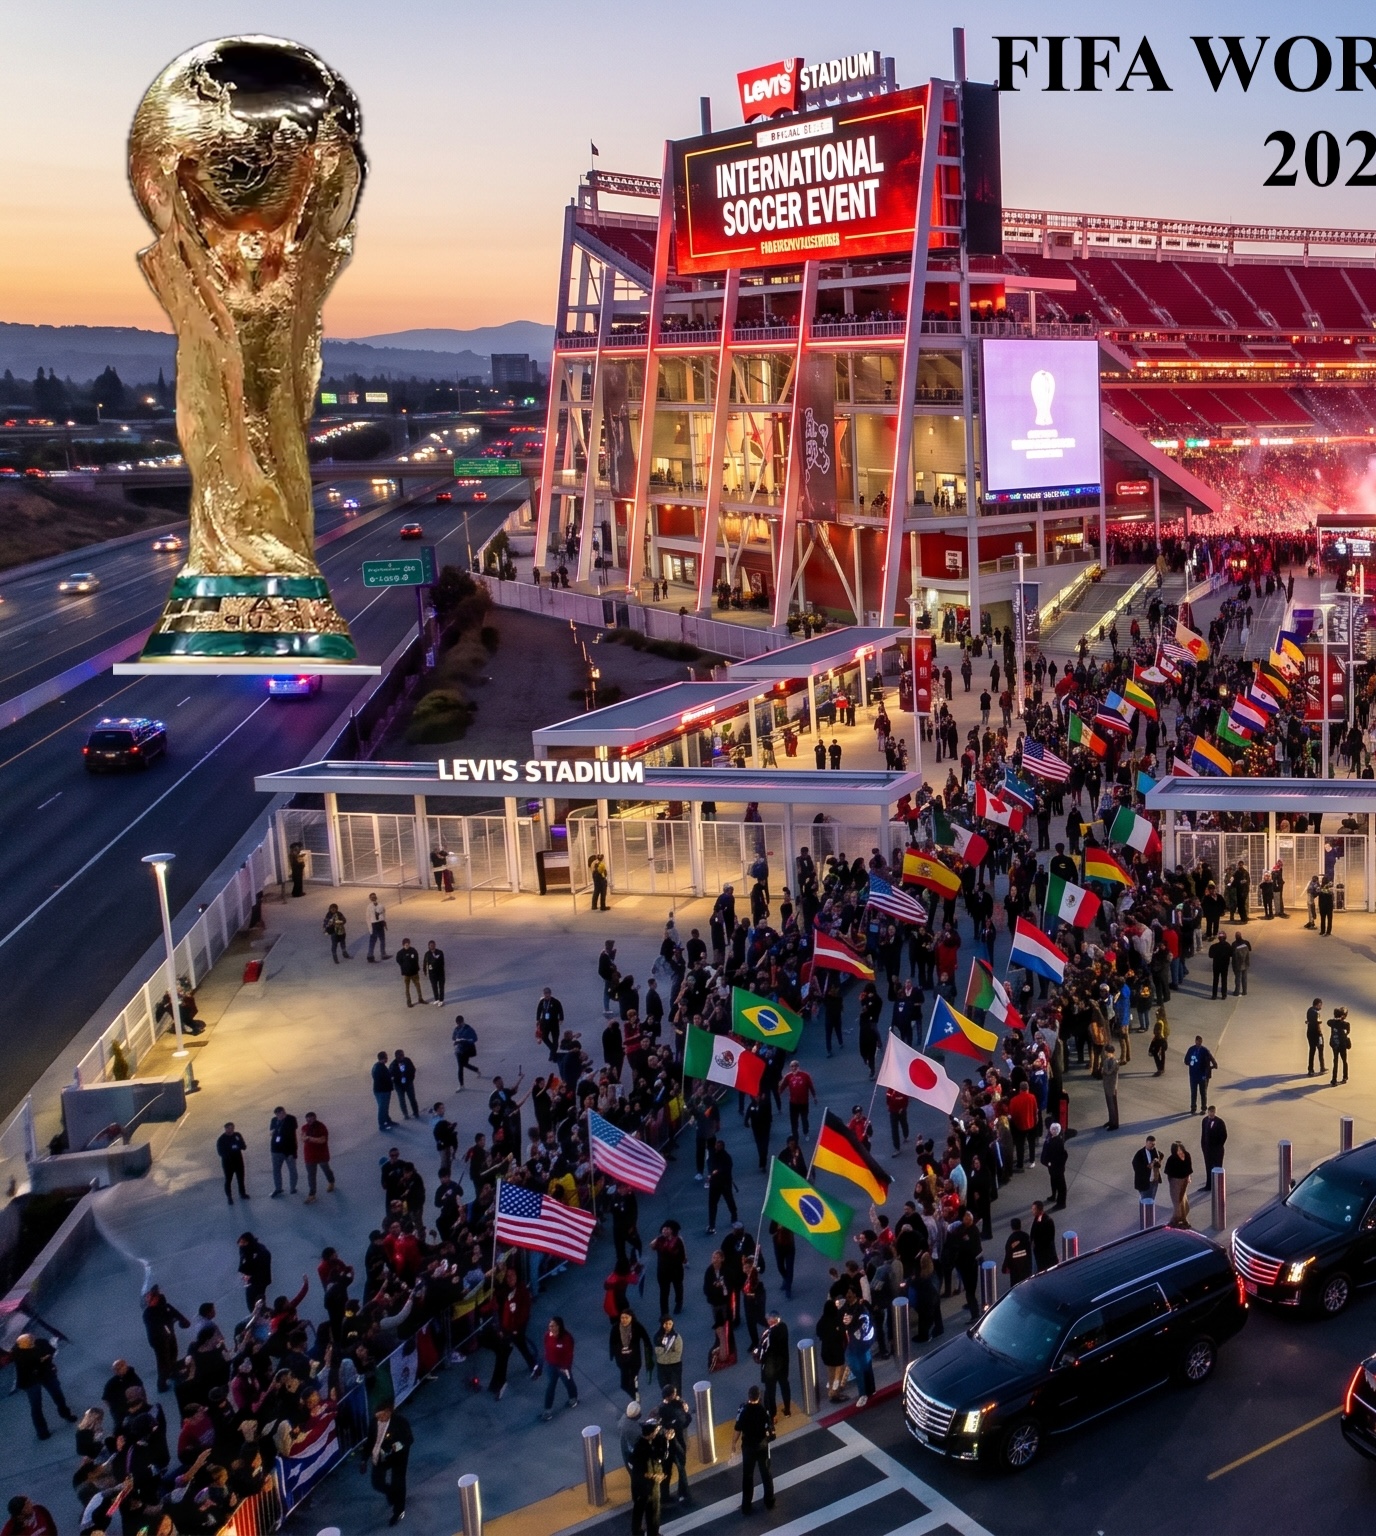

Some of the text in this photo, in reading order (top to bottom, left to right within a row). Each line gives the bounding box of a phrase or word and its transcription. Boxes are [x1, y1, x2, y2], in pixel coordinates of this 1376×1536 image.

[800, 51, 875, 92] STADIUM
[715, 135, 885, 199] INTERNATIONAL
[723, 179, 880, 237] SOCCER EVENT
[438, 758, 644, 783] LEVI'S STADIUM
